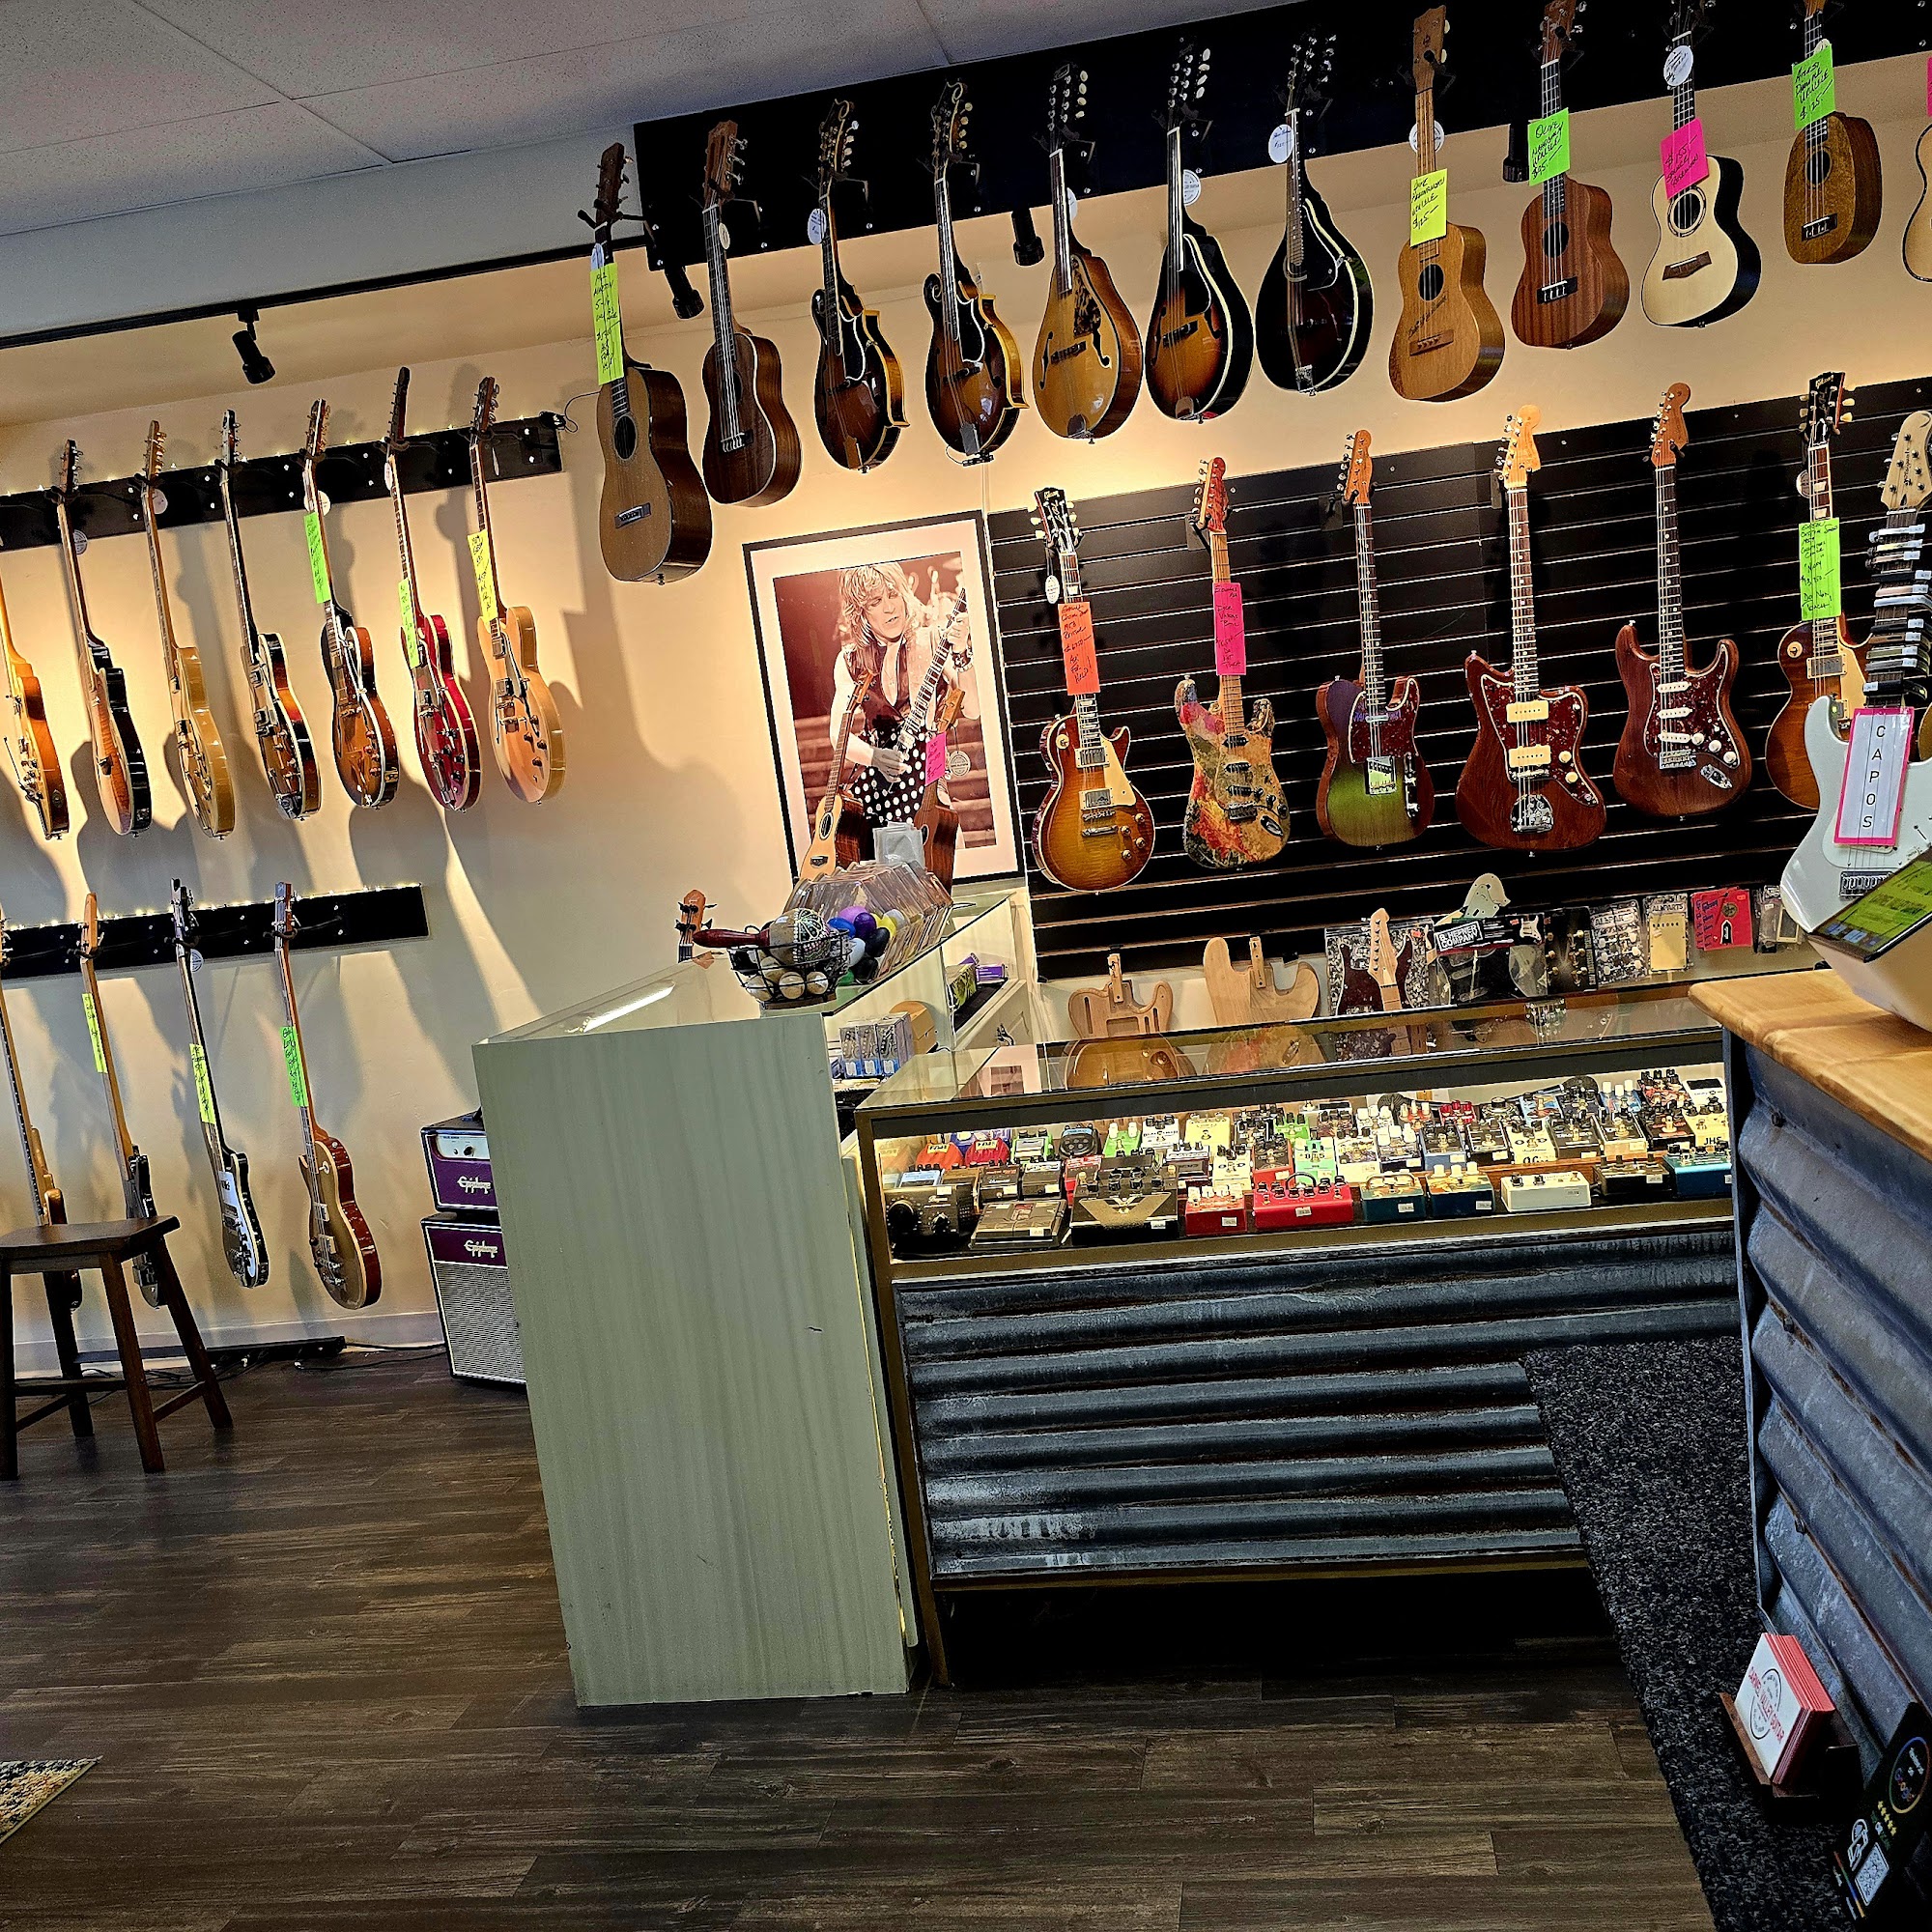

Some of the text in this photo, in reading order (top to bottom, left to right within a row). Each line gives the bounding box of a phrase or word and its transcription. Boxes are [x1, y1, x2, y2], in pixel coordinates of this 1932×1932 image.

[1861, 725, 1887, 828] CAPOS
[1441, 929, 1478, 949] COMPANY
[1448, 924, 1477, 938] HEPNER
